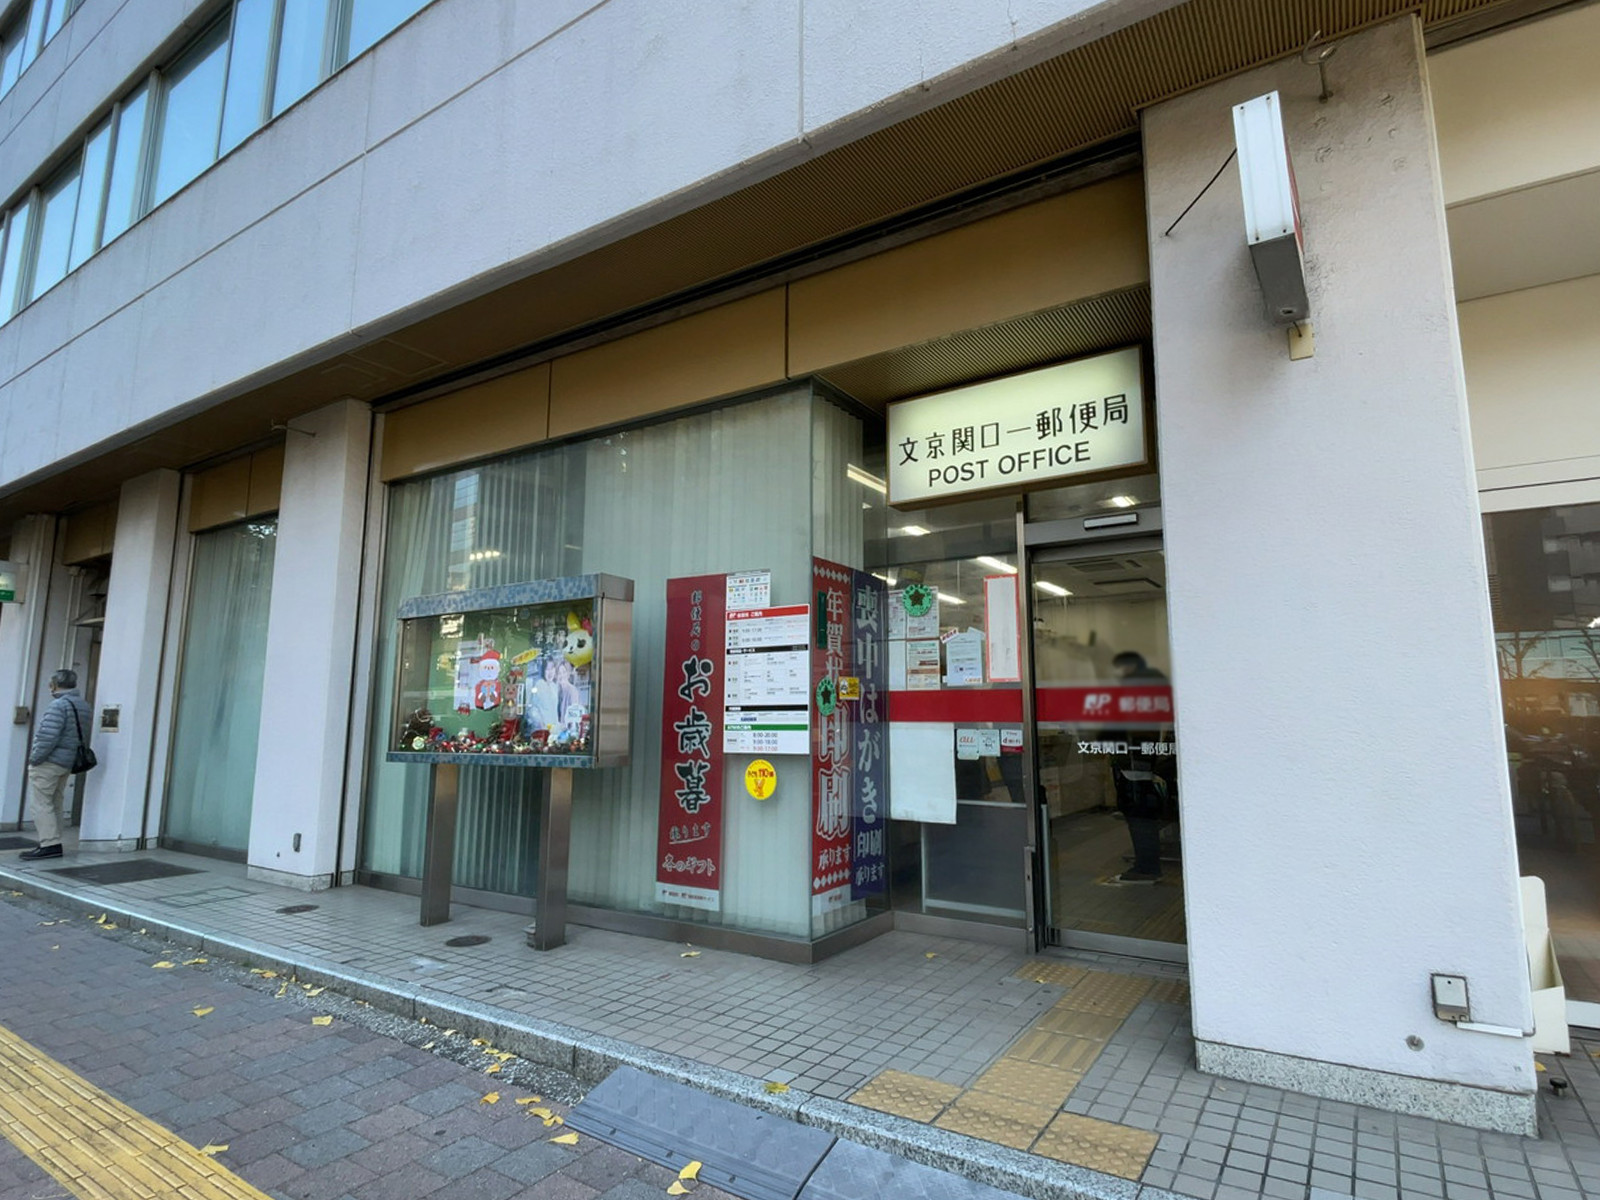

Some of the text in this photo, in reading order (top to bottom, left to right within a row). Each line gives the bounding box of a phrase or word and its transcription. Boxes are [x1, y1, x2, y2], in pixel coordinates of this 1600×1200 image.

[898, 393, 1129, 466] 文京関口一郵便局
[928, 441, 1091, 488] POST OFFICE
[673, 654, 715, 814] お歳暮
[855, 584, 884, 825] 喪中はがき
[661, 852, 717, 877] 冬のギフト
